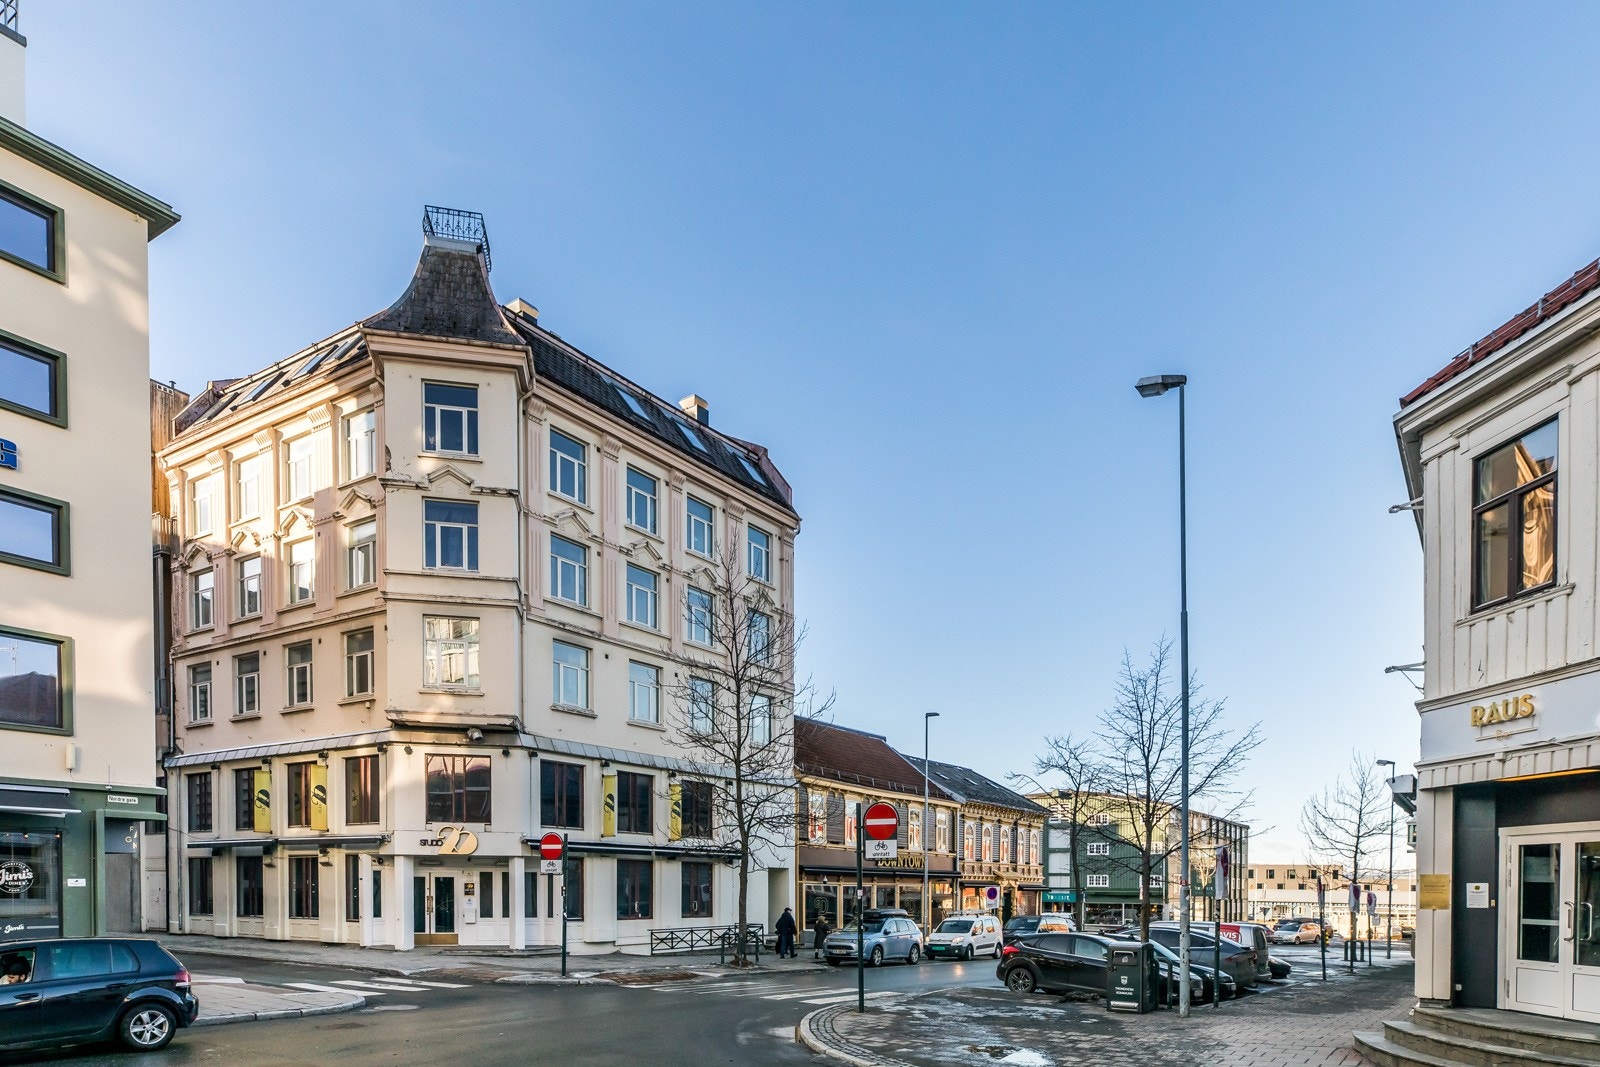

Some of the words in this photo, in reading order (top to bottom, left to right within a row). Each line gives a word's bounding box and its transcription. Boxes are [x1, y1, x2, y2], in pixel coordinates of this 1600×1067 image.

[1471, 693, 1535, 727] RAUS
[419, 838, 444, 847] STUDIO
[0, 868, 34, 886] Jimi's
[4, 924, 25, 934] Jimi's
